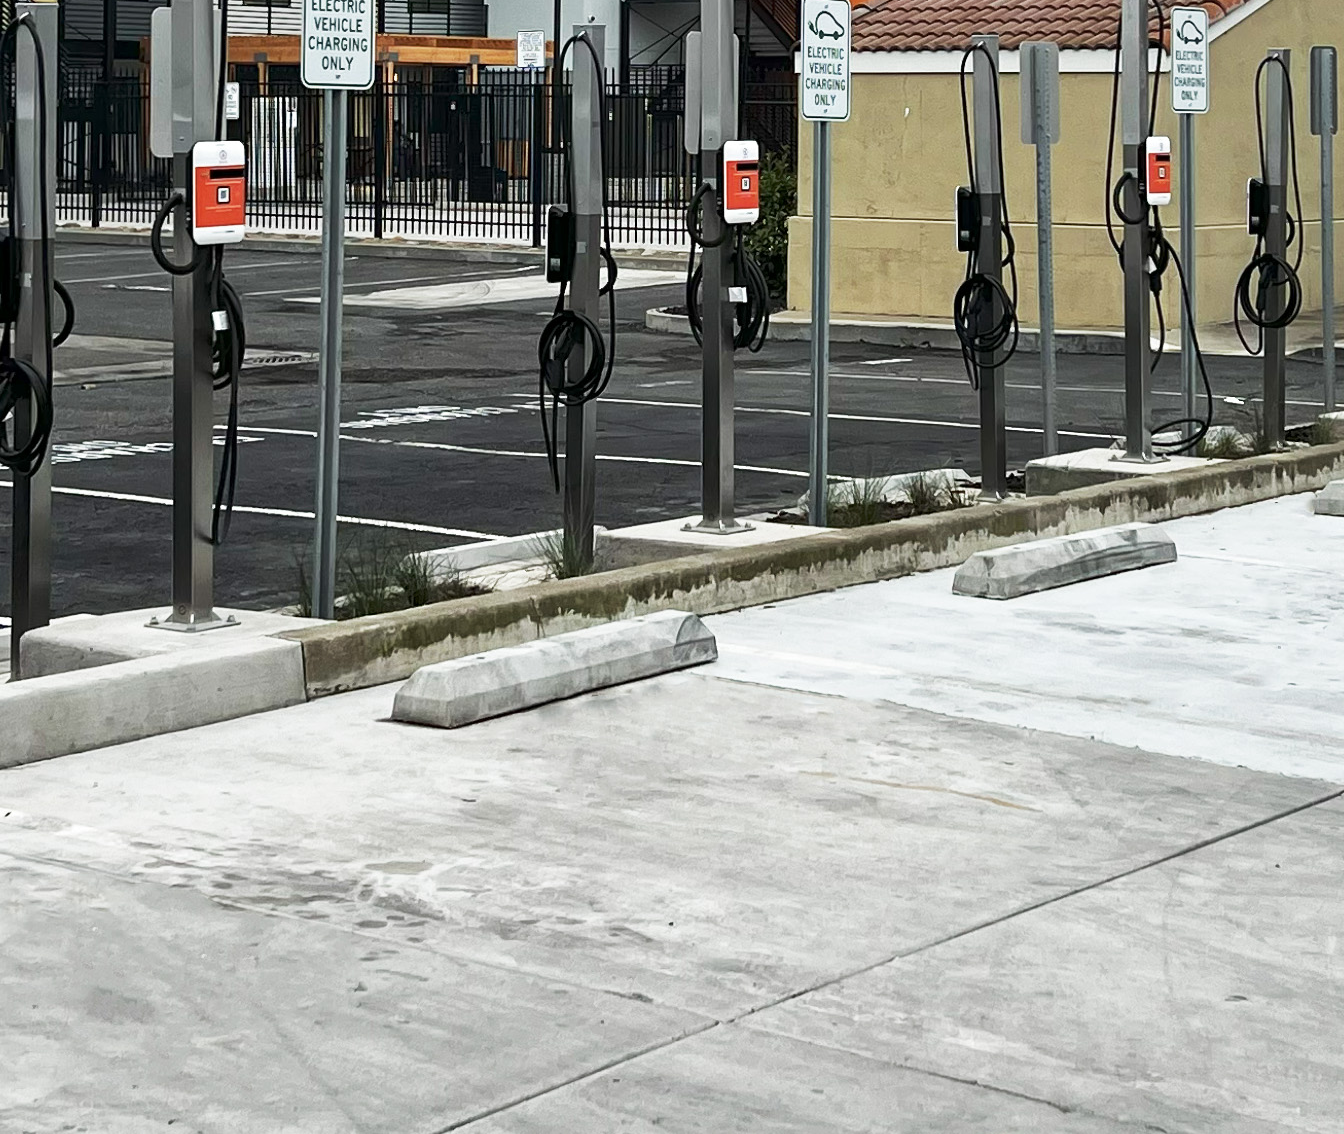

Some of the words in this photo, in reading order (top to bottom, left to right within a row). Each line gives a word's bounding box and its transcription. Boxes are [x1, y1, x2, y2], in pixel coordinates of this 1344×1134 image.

[313, 16, 363, 33] VEHICLE
[308, 35, 368, 53] CHARGING
[807, 45, 845, 60] ELECTRIC
[1175, 50, 1204, 62] ELECTRIC
[321, 55, 354, 71] ONLY
[809, 62, 843, 76] VEHICLE
[1176, 63, 1203, 75] VEHICLE
[805, 78, 846, 91] CHARGING
[1174, 76, 1206, 88] CHARGING
[814, 93, 837, 106] ONLY
[1180, 90, 1199, 101] ONLY
